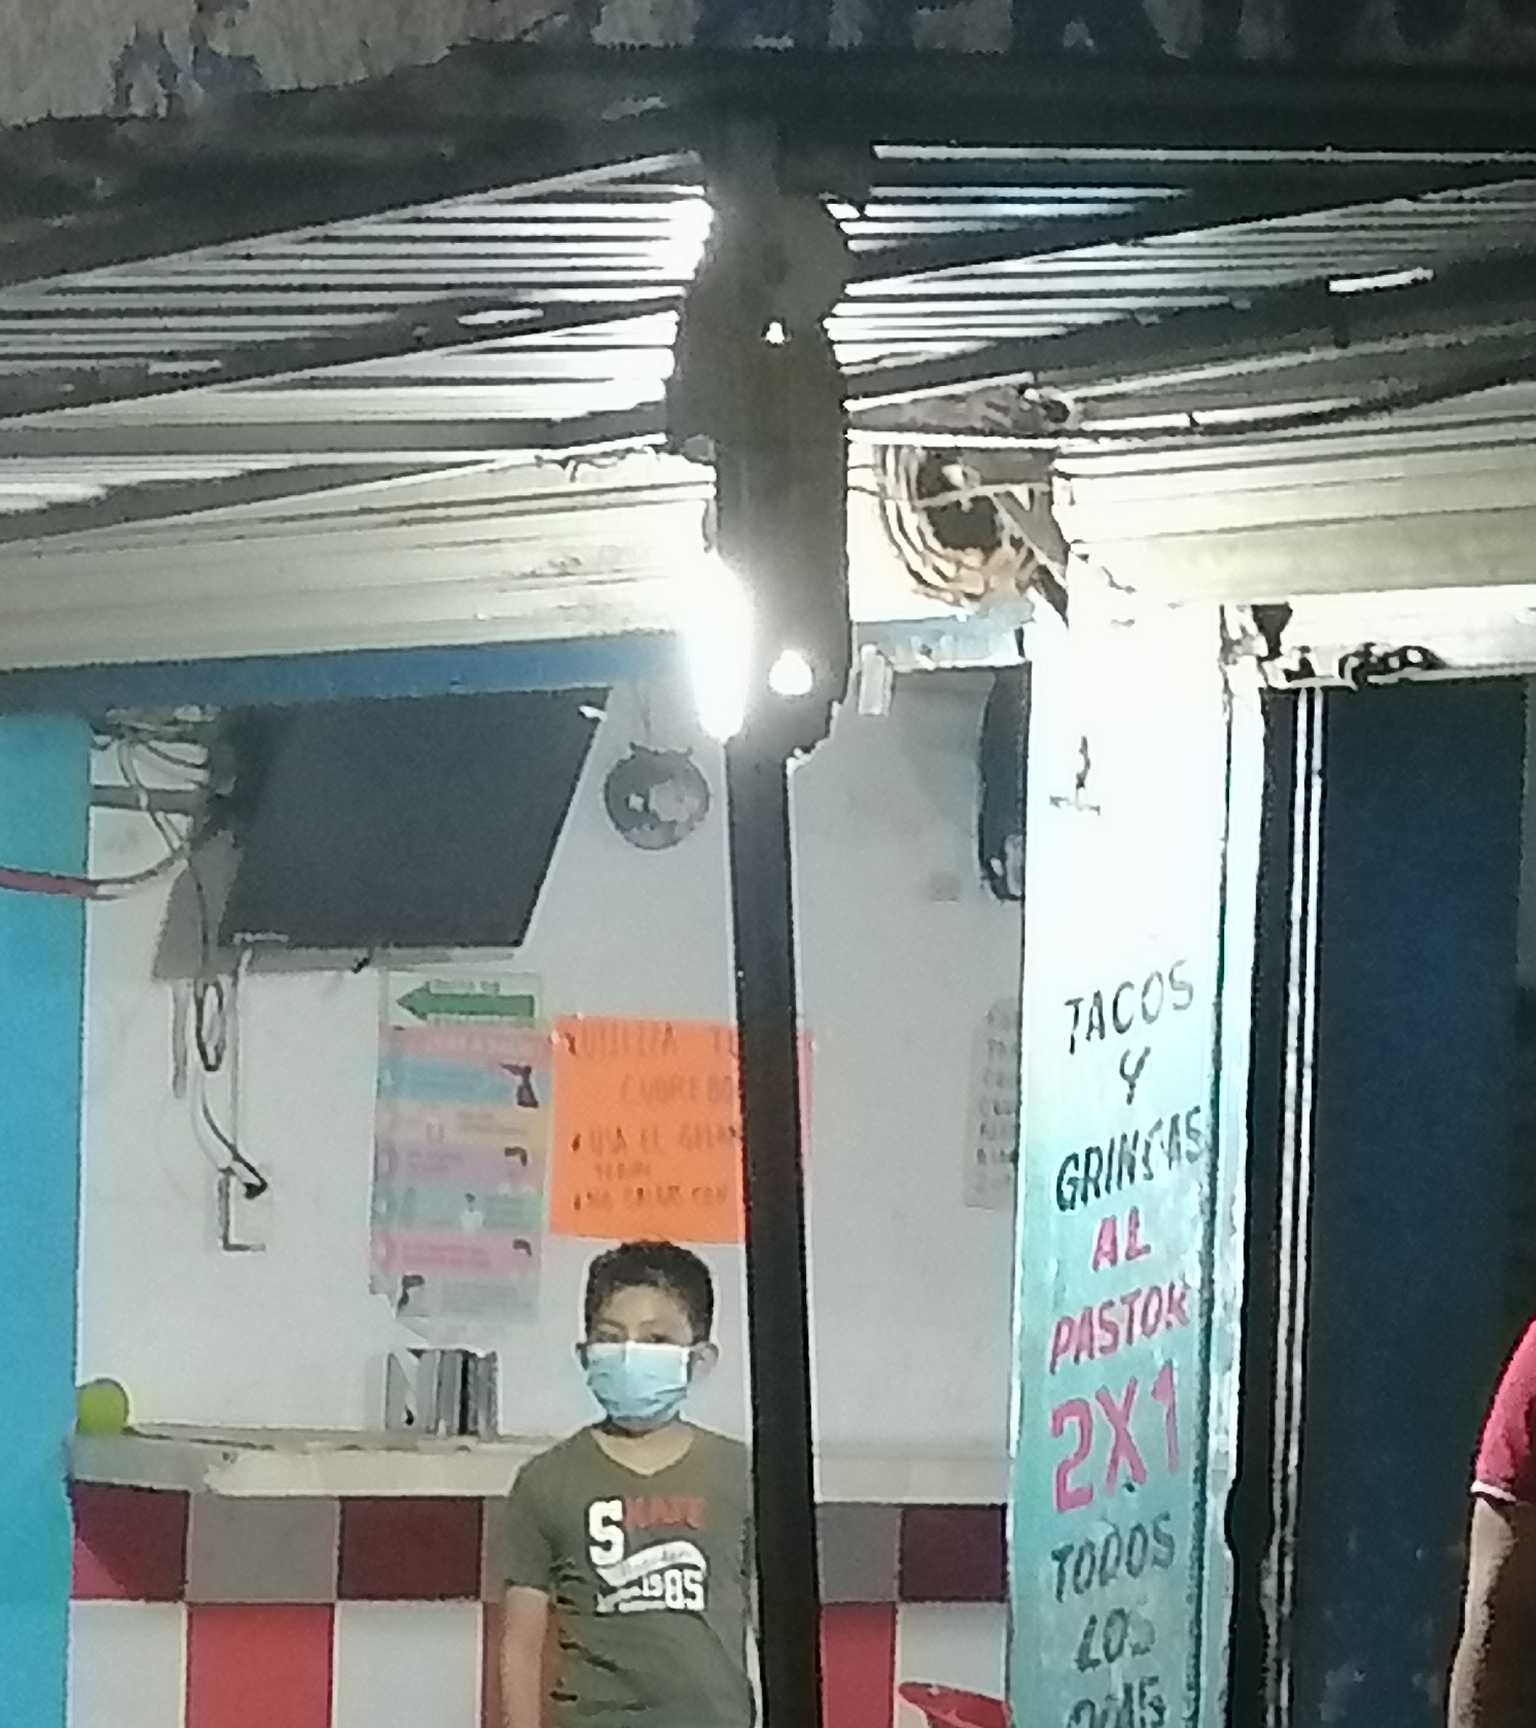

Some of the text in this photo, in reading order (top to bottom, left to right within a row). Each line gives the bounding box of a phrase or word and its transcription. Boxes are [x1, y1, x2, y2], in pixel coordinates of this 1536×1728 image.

[1064, 959, 1195, 1055] TACOS
[1119, 1046, 1152, 1105] Y
[1091, 1205, 1153, 1273] AL
[1048, 1281, 1191, 1375] PASTOR
[1049, 1359, 1180, 1514] 2X1
[1050, 1511, 1178, 1603] TODOS
